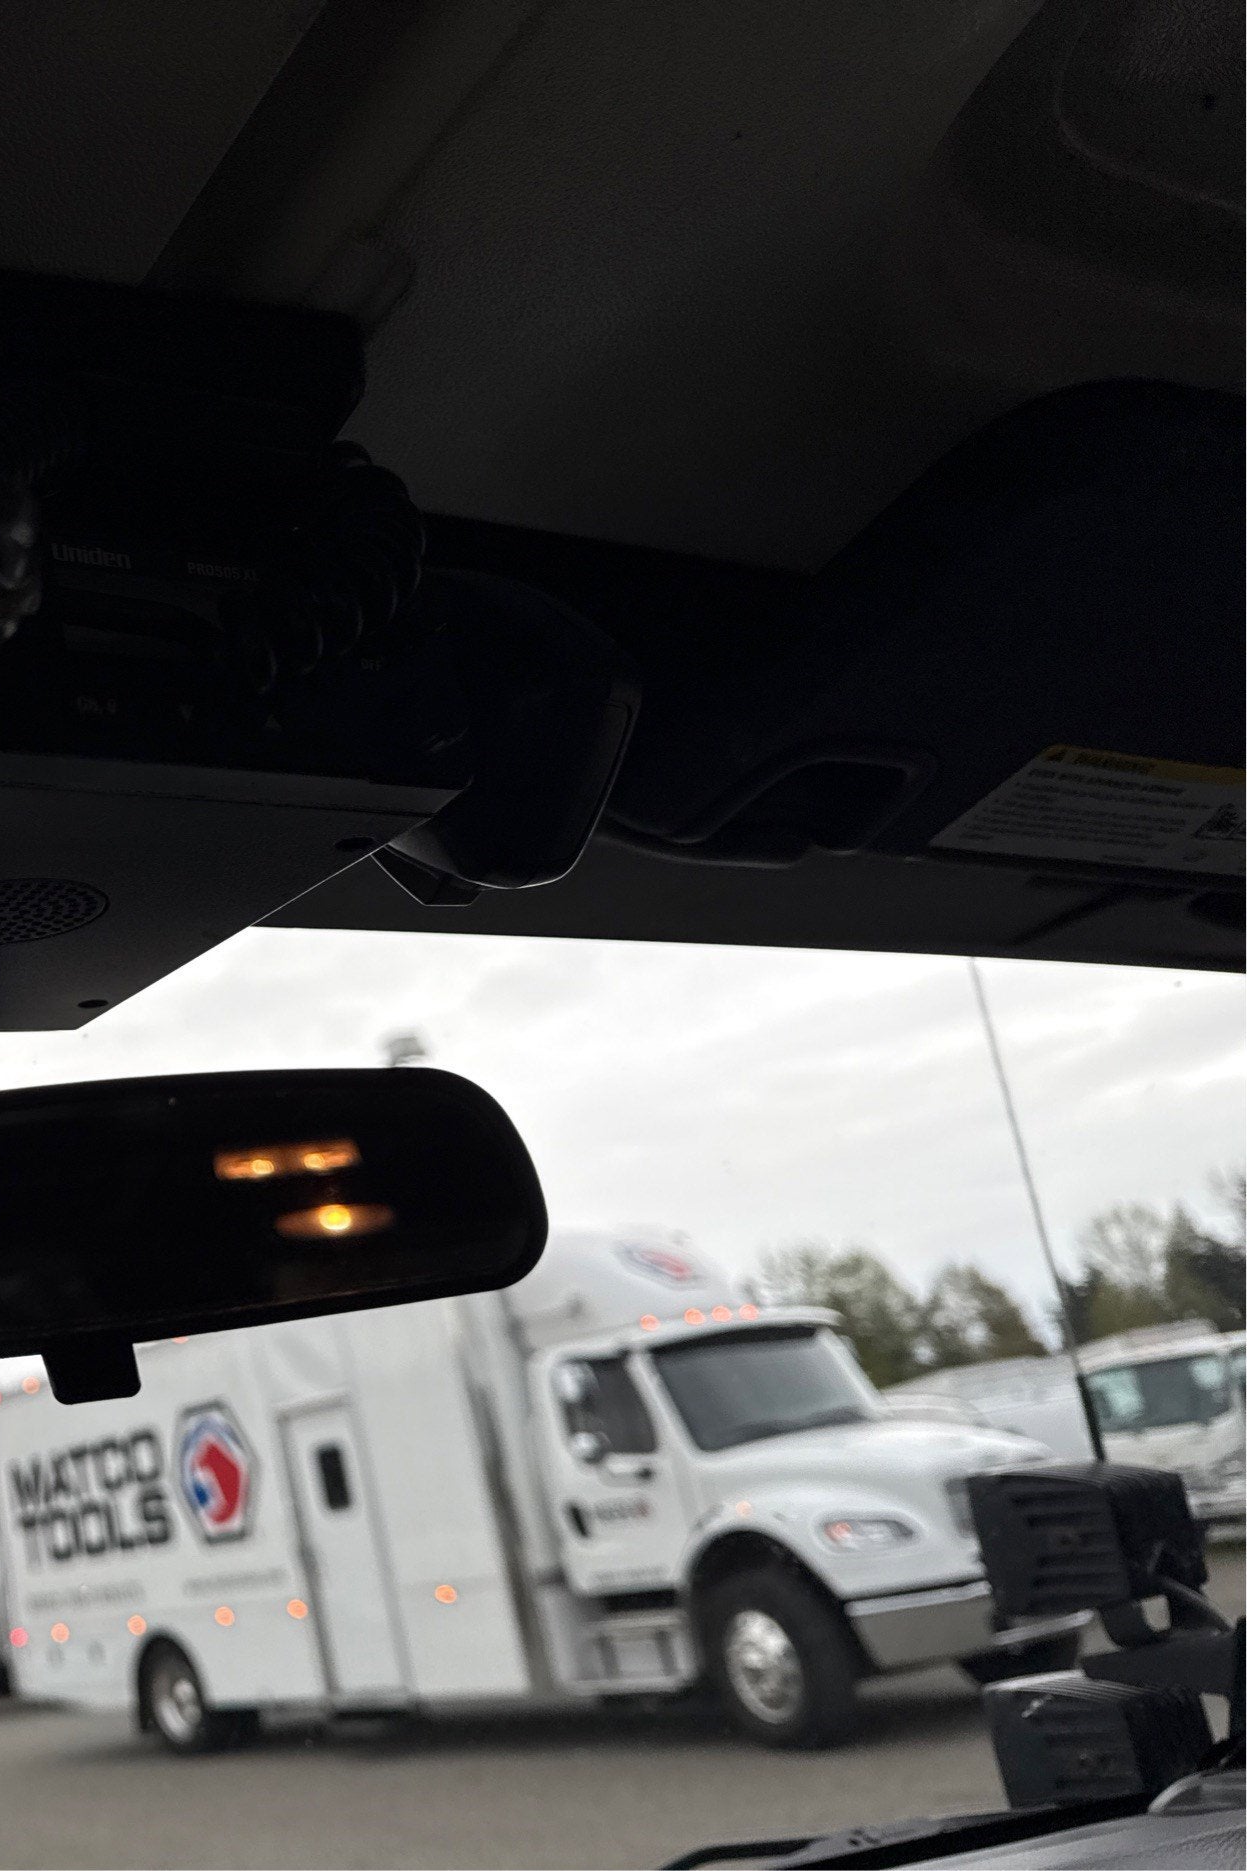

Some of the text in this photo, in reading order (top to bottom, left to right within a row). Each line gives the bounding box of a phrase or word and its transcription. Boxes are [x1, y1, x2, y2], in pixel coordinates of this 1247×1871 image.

[51, 542, 132, 569] Uniden
[11, 1428, 160, 1504] MATCO
[21, 1488, 171, 1566] TOOLS
